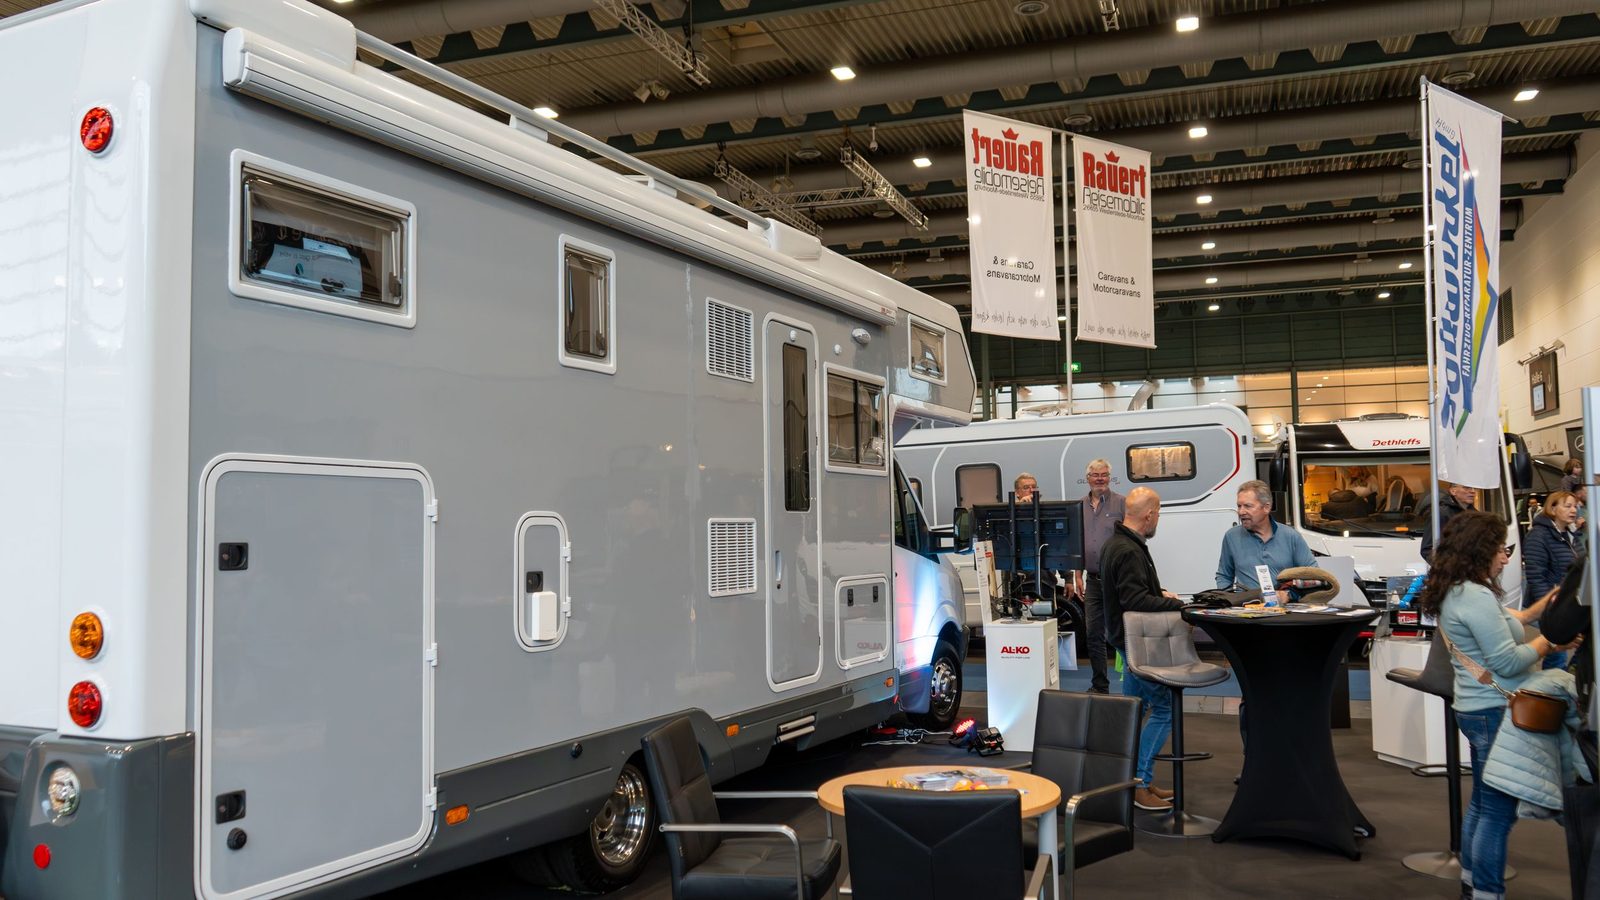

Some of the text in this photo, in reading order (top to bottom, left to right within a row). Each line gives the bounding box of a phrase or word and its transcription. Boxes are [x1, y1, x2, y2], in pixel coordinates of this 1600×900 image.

[1082, 151, 1147, 199] Rauert
[1097, 271, 1129, 285] Caravans
[1092, 282, 1141, 298] Motorcaravans
[1462, 207, 1473, 377] FAHRZEUG-REPARATUR-ZENTRUM
[1372, 437, 1421, 447] Dethleffs
